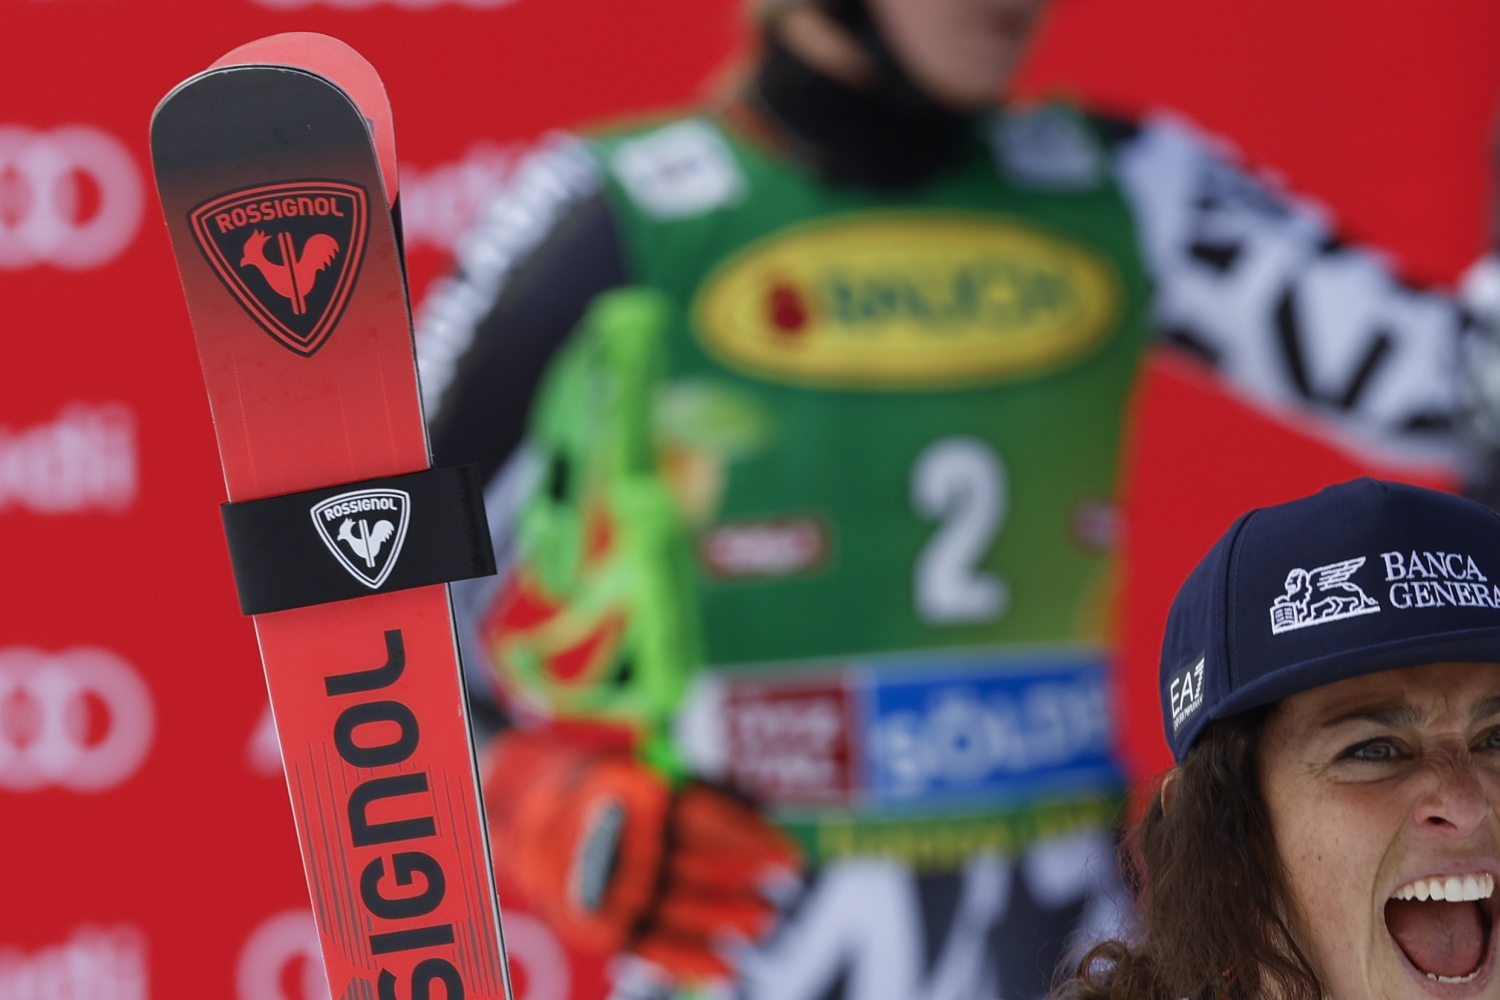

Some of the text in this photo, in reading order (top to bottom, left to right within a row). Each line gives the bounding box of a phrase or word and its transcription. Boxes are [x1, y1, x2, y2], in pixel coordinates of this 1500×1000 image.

[215, 197, 345, 234] ROSSIGNOL
[324, 497, 398, 521] ROSSIGNOL
[911, 437, 1010, 625] 2
[1380, 550, 1488, 582] BANCA
